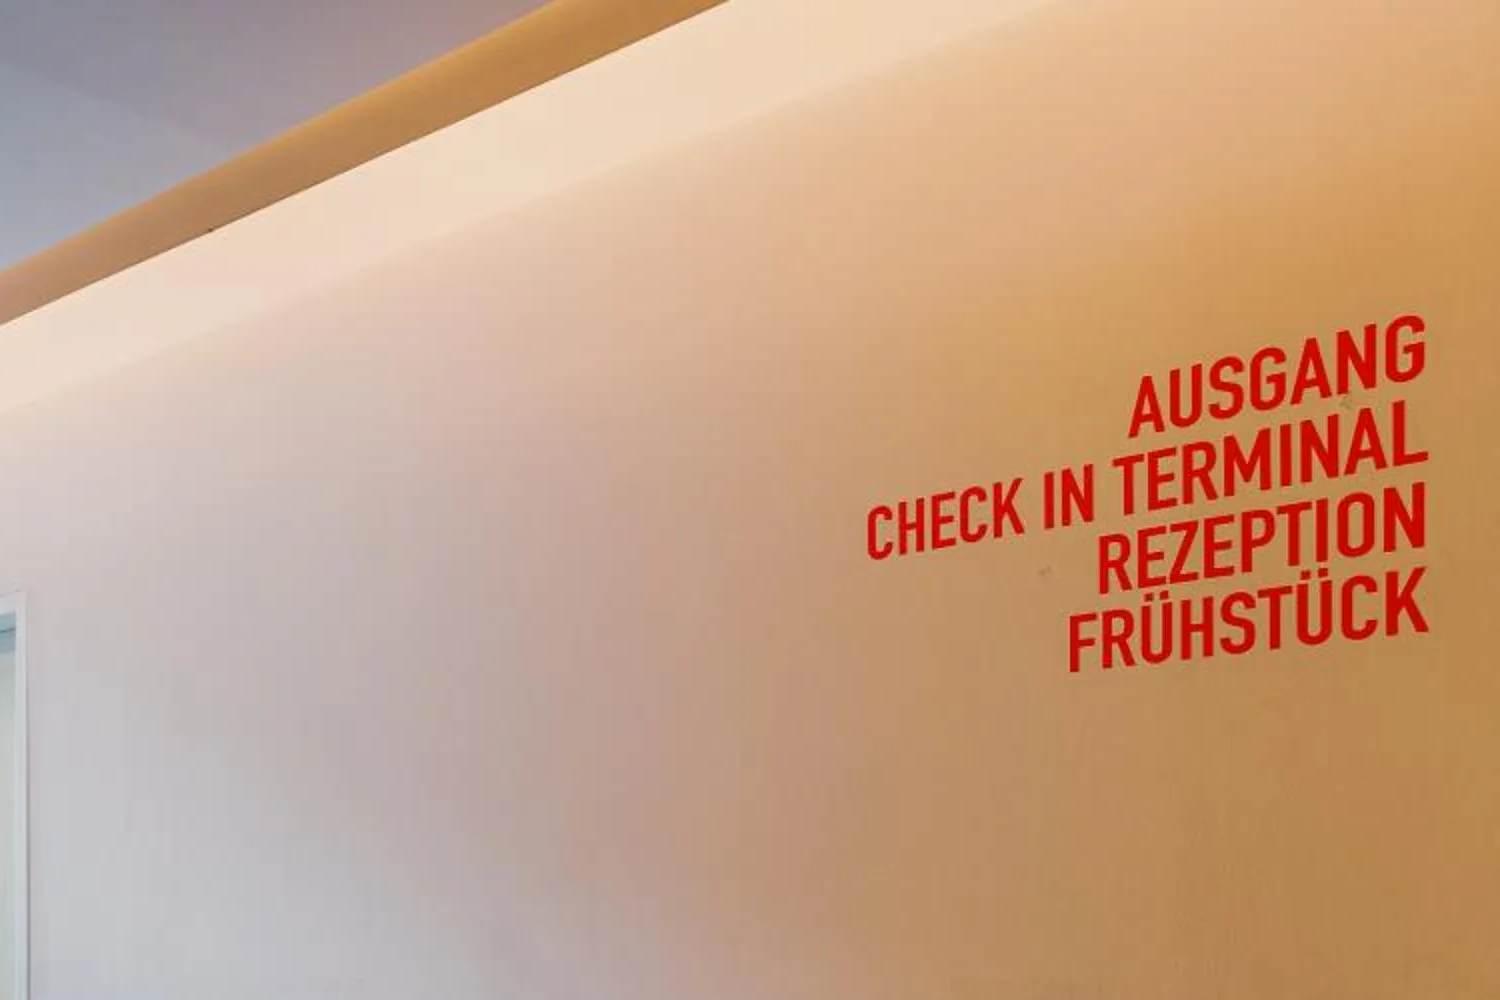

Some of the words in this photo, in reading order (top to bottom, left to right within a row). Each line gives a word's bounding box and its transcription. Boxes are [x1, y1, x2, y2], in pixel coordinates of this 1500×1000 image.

[1127, 314, 1426, 439] AUSGANG
[867, 478, 1026, 561] CHECK
[1043, 463, 1095, 530] IN
[1111, 399, 1430, 517] TERMINAL
[1097, 480, 1427, 596] REZEPTION
[1068, 566, 1429, 673] FRÜHSTÜCK
